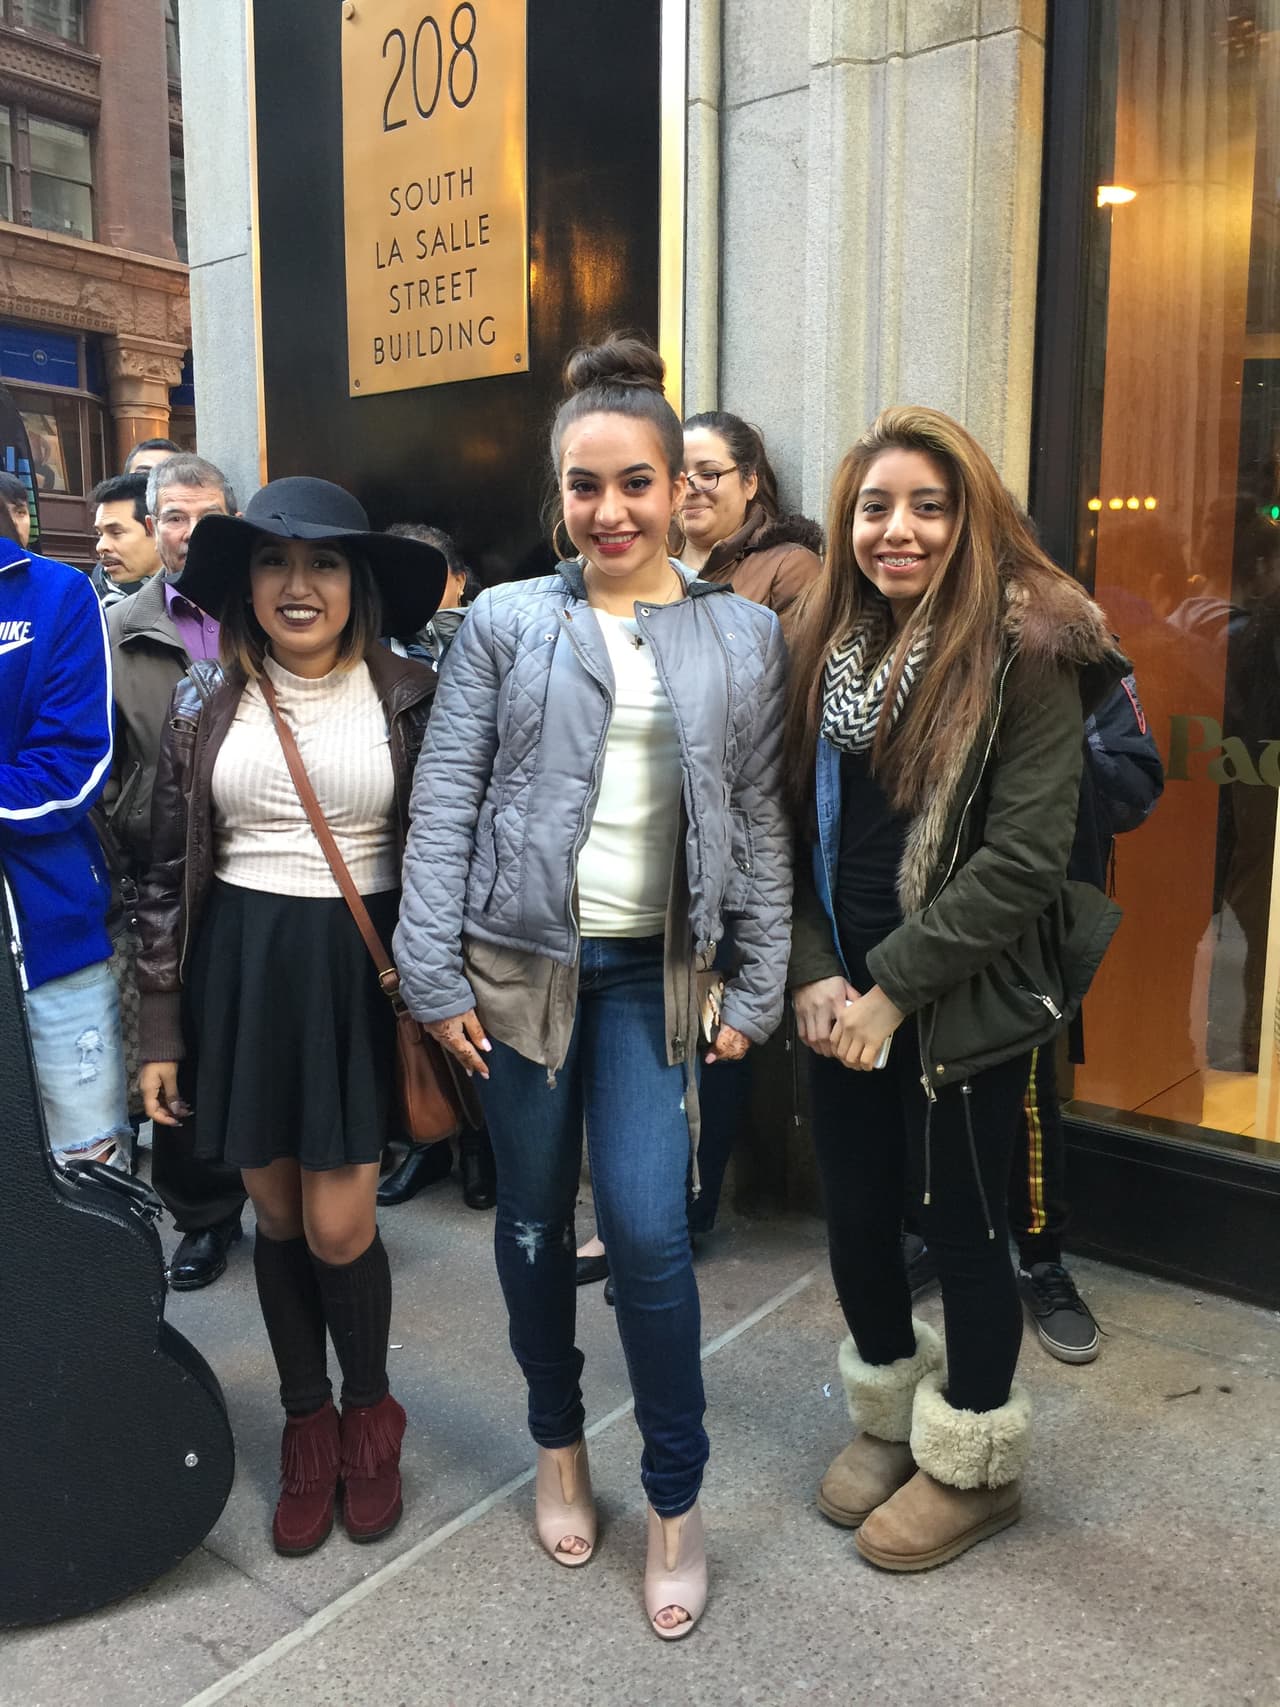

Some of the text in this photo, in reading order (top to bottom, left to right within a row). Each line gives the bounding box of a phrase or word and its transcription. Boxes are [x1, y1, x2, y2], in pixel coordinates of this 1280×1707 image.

[382, 2, 478, 132] 208
[389, 166, 474, 217] SOUTH
[375, 213, 490, 270] LA SALLE
[388, 267, 478, 314] STREET
[373, 315, 496, 365] BUILDING
